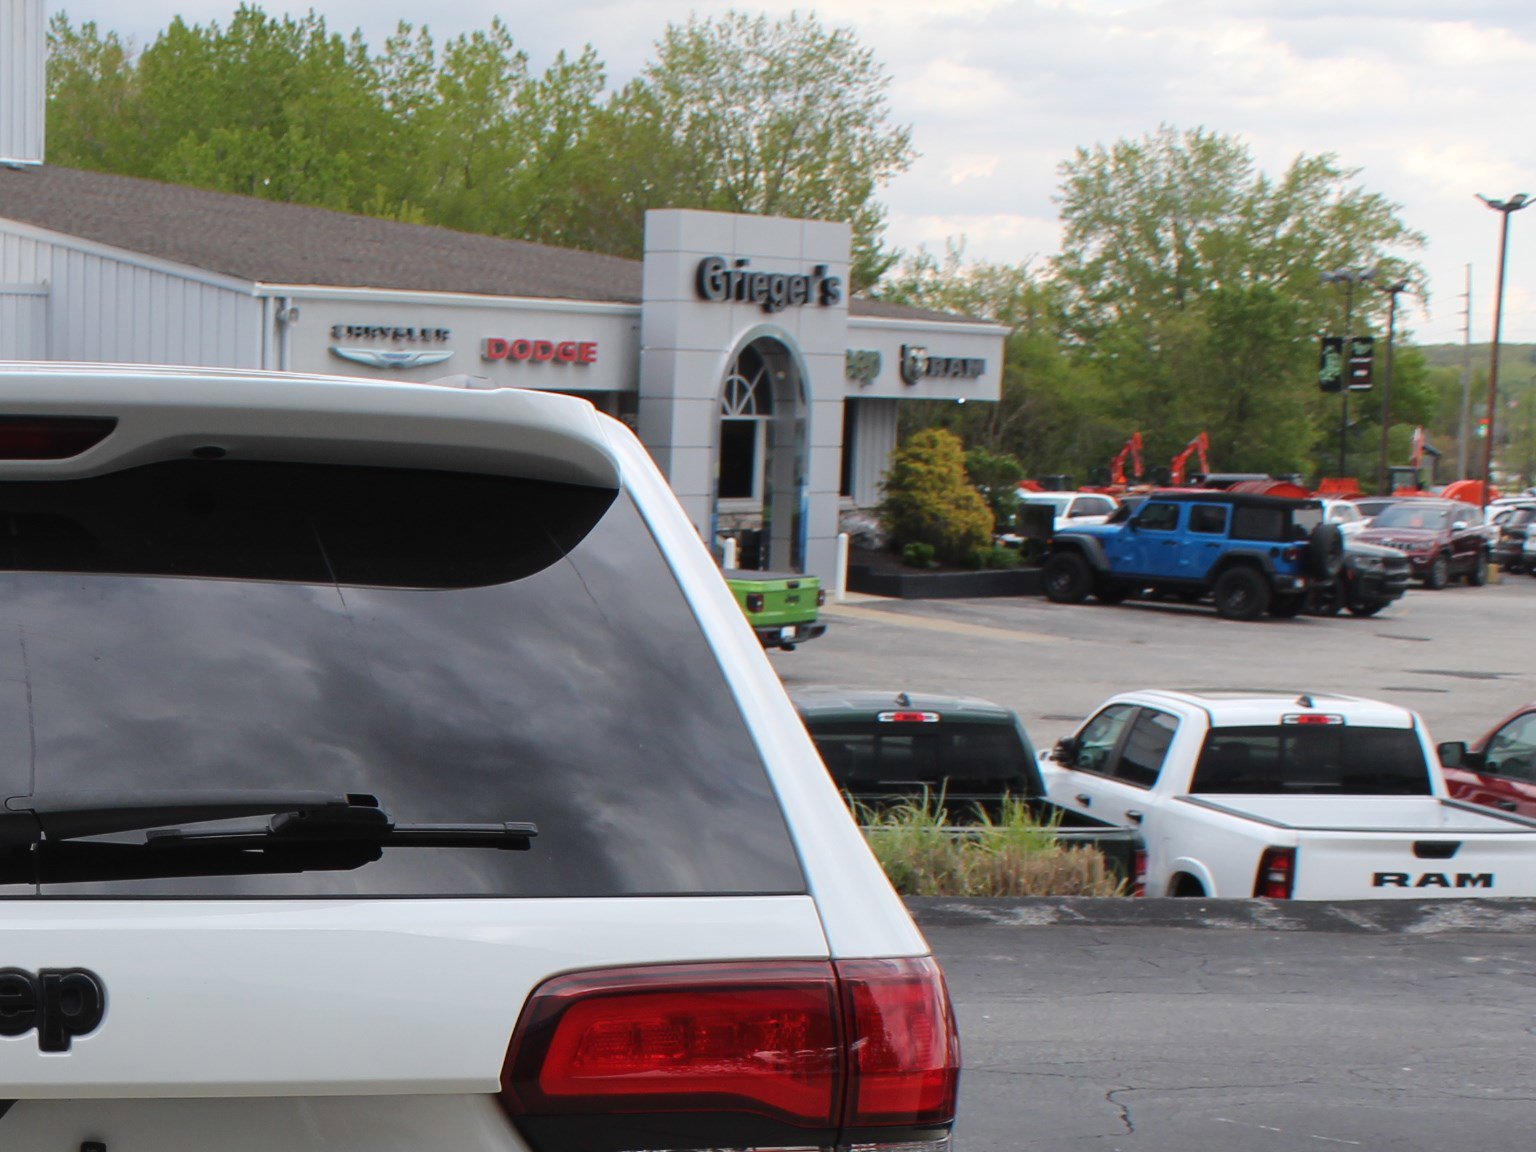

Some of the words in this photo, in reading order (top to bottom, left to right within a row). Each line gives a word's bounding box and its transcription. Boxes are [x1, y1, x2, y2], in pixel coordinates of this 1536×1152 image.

[696, 255, 842, 314] Grieger's
[482, 336, 598, 364] DODGE
[925, 356, 986, 379] RAM
[1372, 872, 1495, 888] RAM
